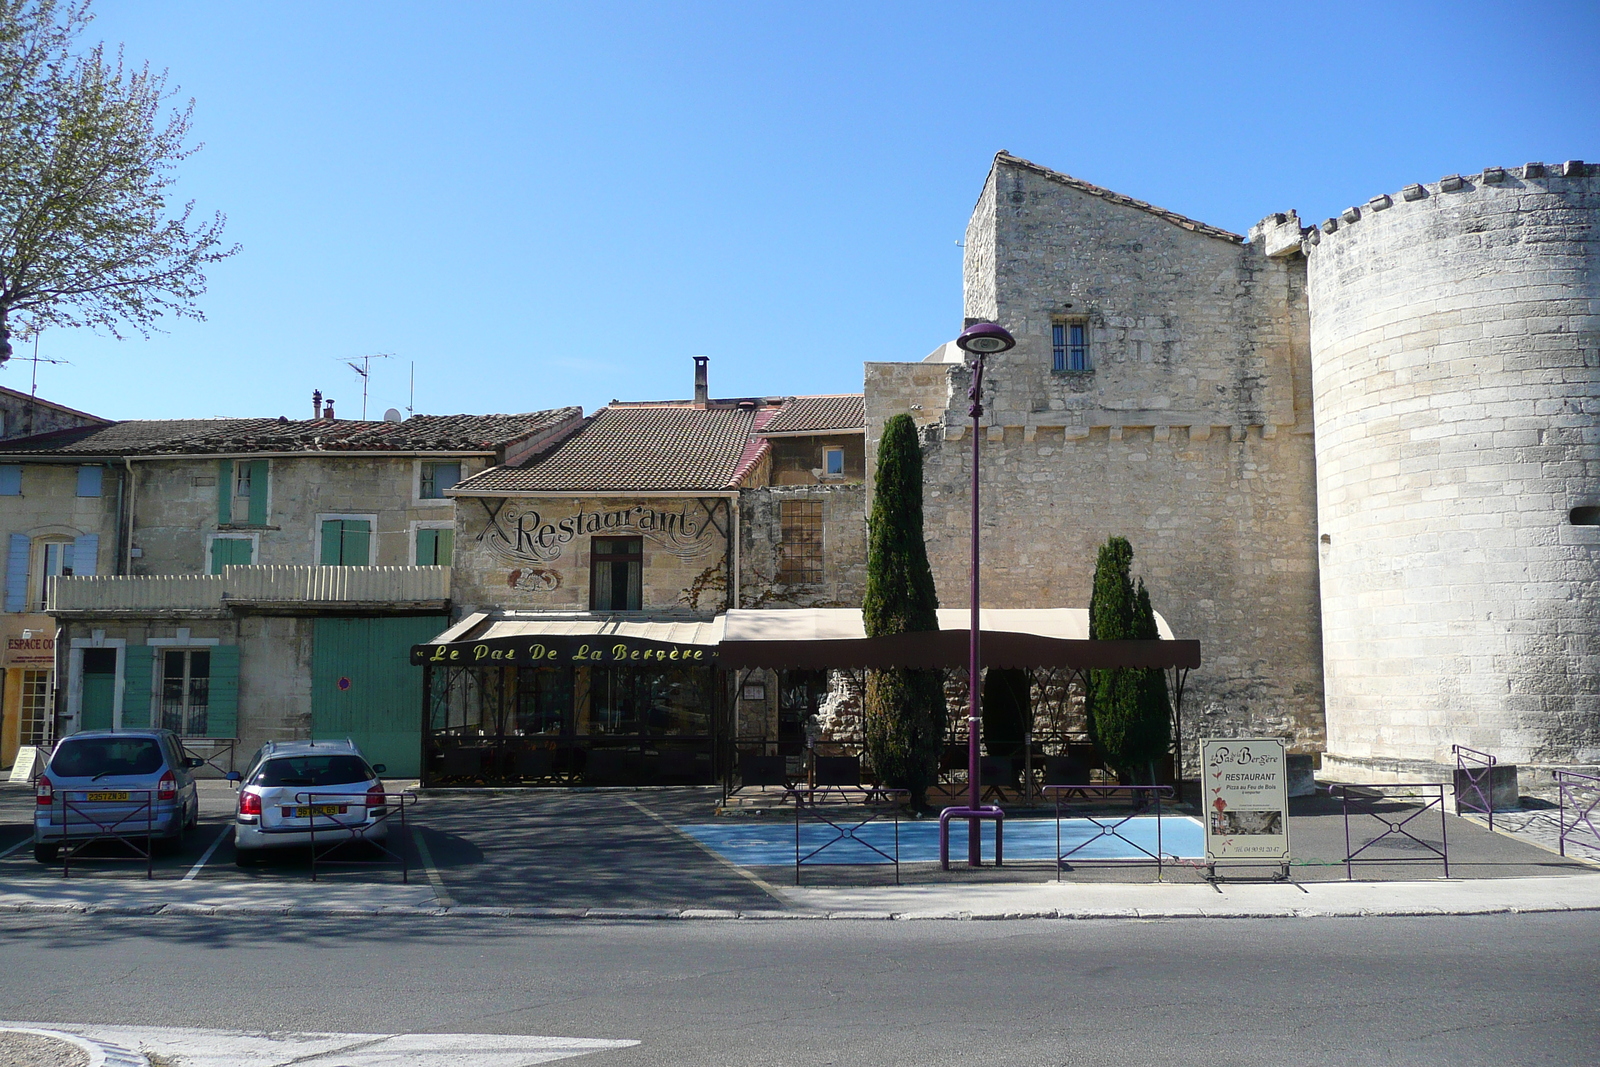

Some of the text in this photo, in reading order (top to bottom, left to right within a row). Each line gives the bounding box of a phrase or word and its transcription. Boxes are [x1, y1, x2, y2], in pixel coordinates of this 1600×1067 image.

[505, 502, 699, 553] Restaurant
[8, 638, 41, 650] ESPACE
[429, 645, 460, 662] Le
[473, 644, 516, 661] Pas
[528, 643, 557, 660] De
[572, 644, 602, 660] La
[612, 643, 703, 661] Bergère
[1215, 746, 1234, 764] Pas
[1237, 746, 1278, 767] Bergère
[1225, 773, 1276, 781] RESTAURANT
